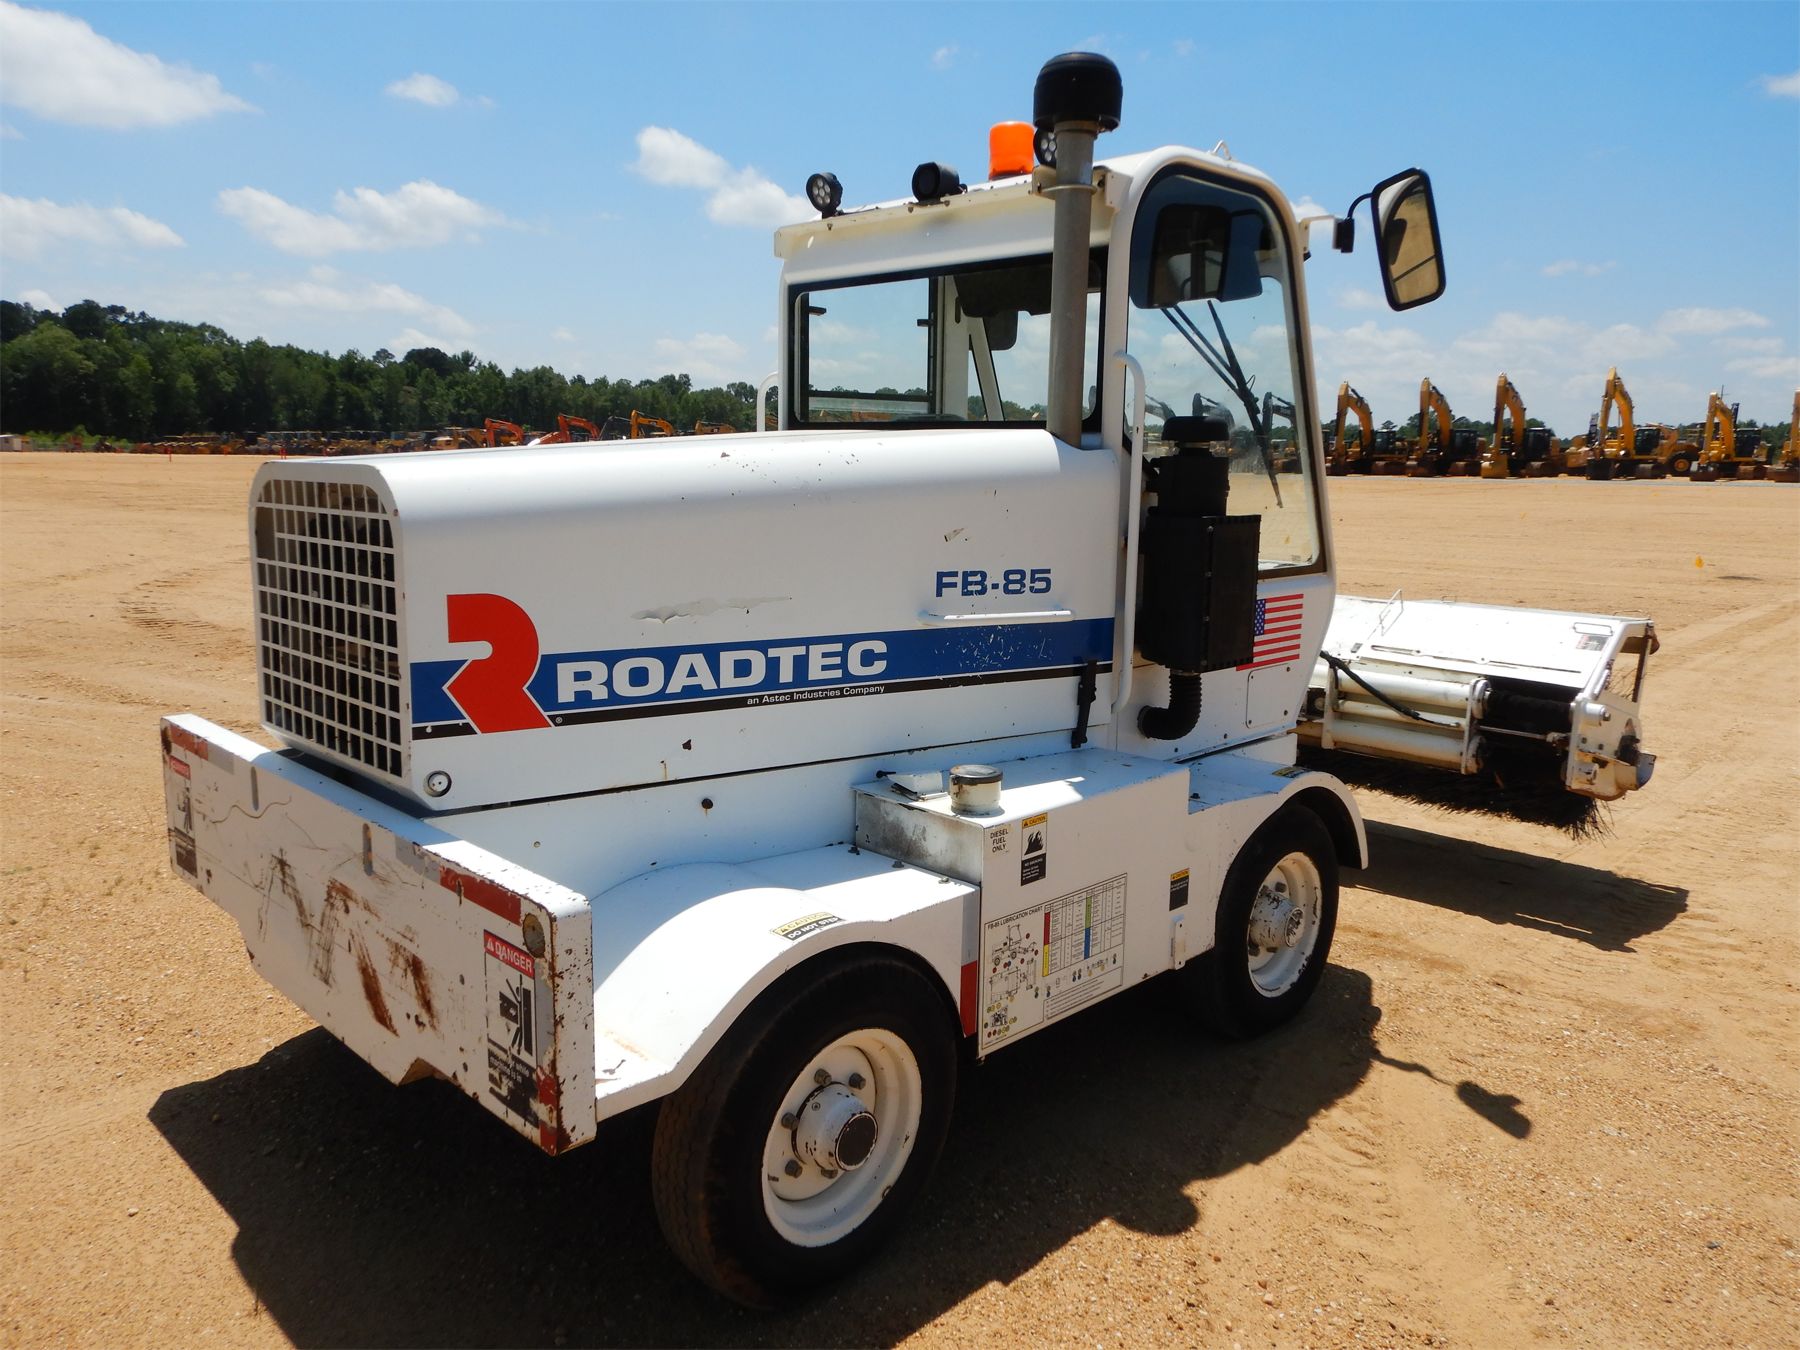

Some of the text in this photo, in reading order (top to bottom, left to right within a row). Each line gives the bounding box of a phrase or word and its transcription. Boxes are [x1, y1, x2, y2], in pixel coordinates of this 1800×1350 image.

[935, 568, 1052, 598] FB-85
[556, 639, 888, 704] ROADTEC
[746, 684, 885, 705] an Astec Industries Company
[990, 828, 1009, 839] DIESEL
[992, 836, 1006, 846] FUEL
[992, 843, 1007, 853] ONLY
[787, 912, 830, 929] CAUTION
[1000, 910, 1029, 926] LUBRICATION
[1028, 905, 1043, 916] CHART
[787, 917, 839, 939] DO NOT STEP
[494, 941, 533, 974] DANGER
